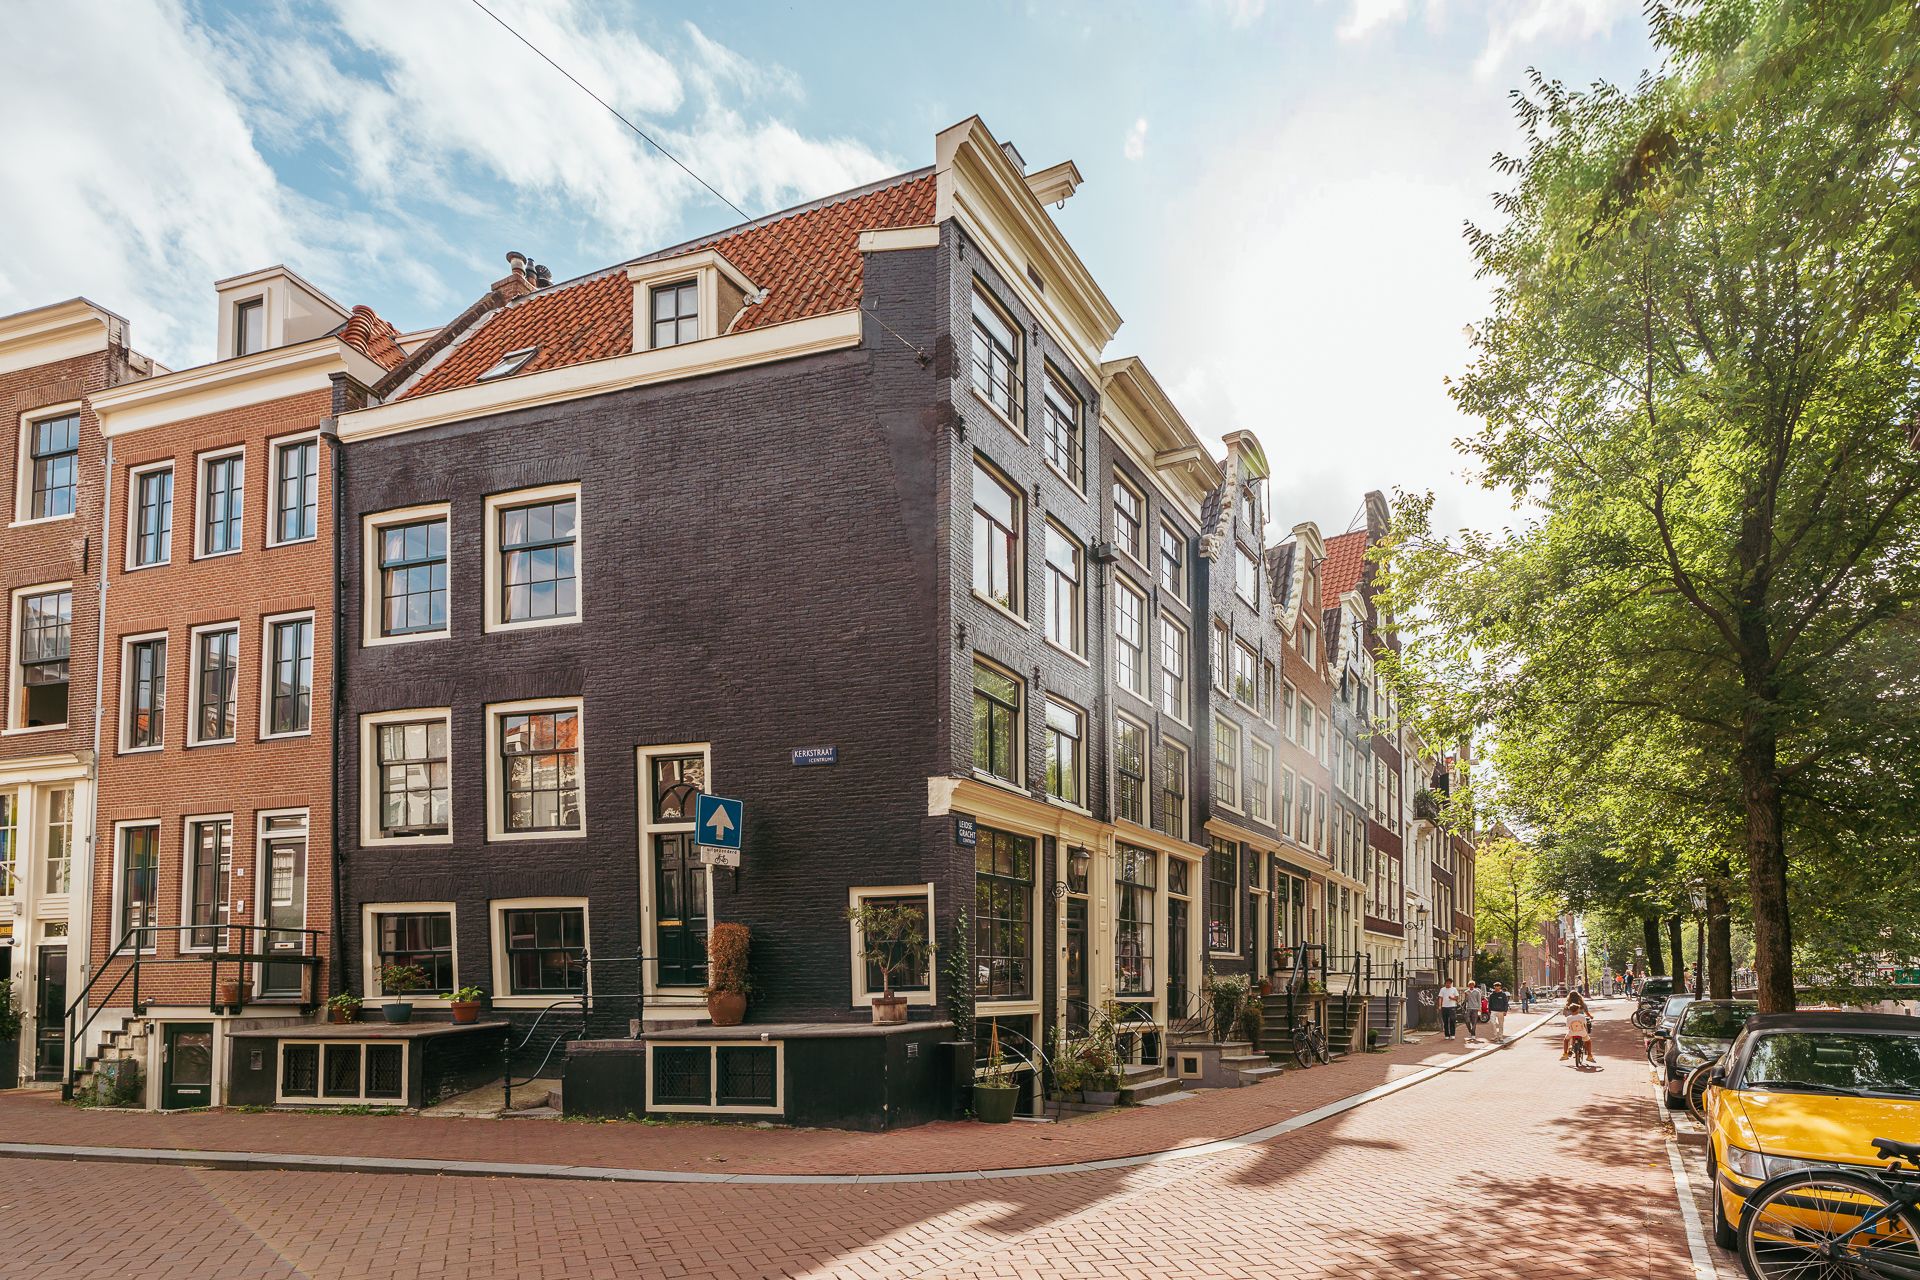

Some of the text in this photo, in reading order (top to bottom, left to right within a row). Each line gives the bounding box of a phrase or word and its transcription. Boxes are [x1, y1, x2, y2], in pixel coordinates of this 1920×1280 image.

[794, 748, 833, 758] KERKSTRAAT
[959, 820, 972, 830] LEIDSE
[959, 829, 975, 839] GRACHT
